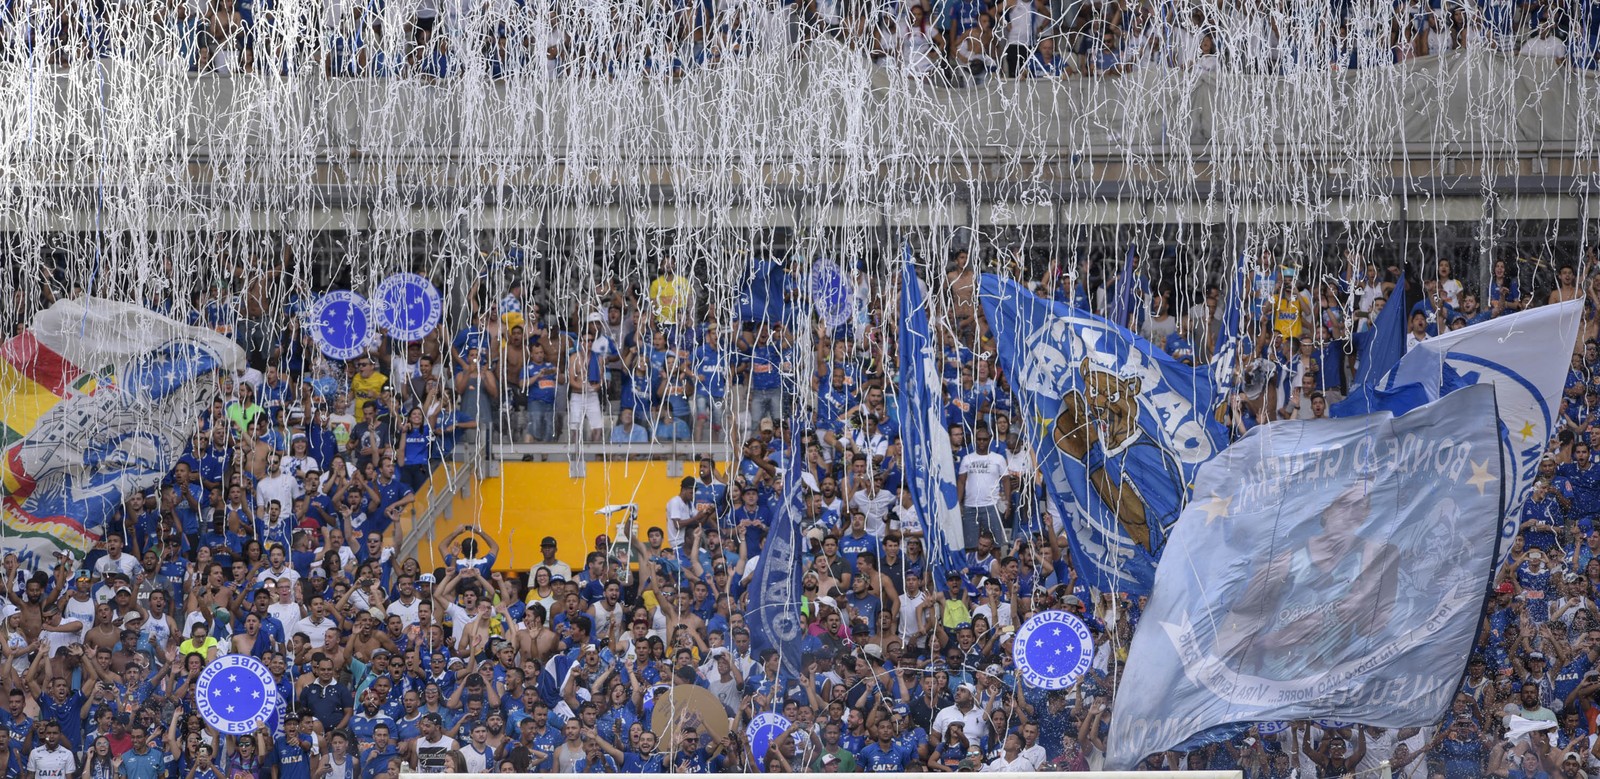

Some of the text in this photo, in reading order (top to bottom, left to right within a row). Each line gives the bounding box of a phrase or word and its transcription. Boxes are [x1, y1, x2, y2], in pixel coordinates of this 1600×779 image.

[843, 546, 867, 554] CAIXA
[137, 592, 150, 600] CAI
[1026, 612, 1088, 640] CRUZEIRO
[231, 656, 273, 685] CLUBE
[1016, 639, 1053, 688] ESPORTE
[1059, 648, 1092, 687] CLUBE
[1556, 673, 1579, 681] AIXA
[198, 661, 223, 725] CRUZEIRO
[228, 689, 275, 732] ESPORTE
[281, 756, 302, 764] CAIXA
[872, 763, 898, 771] CAIXA
[39, 769, 62, 777] CAIXA
